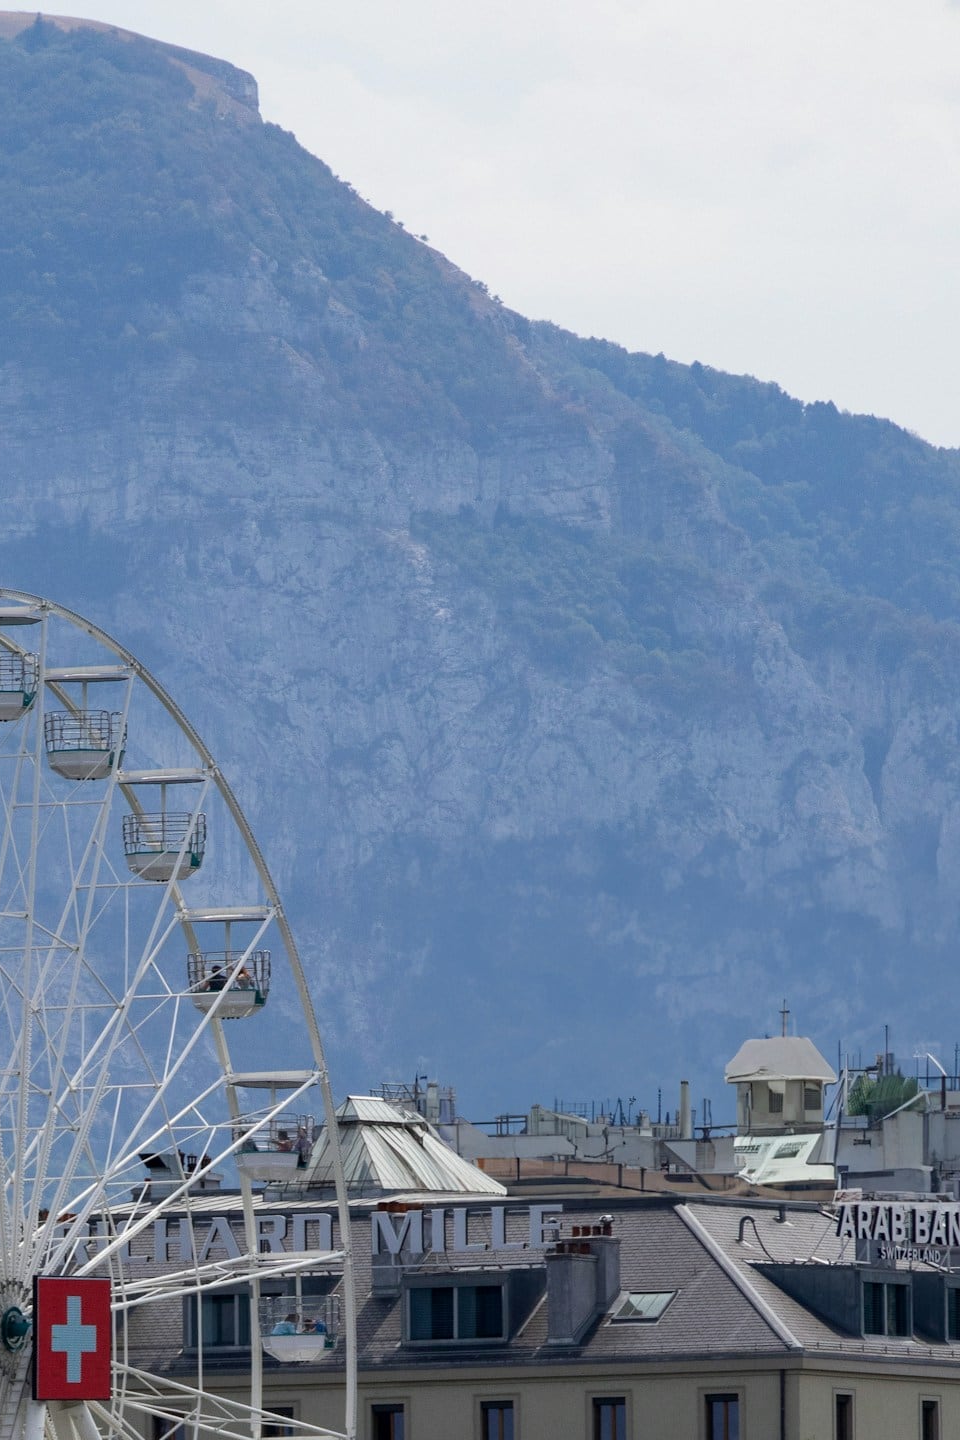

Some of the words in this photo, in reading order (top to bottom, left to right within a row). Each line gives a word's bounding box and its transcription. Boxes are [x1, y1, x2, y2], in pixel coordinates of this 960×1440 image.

[52, 1212, 333, 1267] RICHARD
[371, 1204, 563, 1255] MILLE
[838, 1203, 905, 1242] ARAB
[880, 1245, 941, 1263] SWITZERLAND
